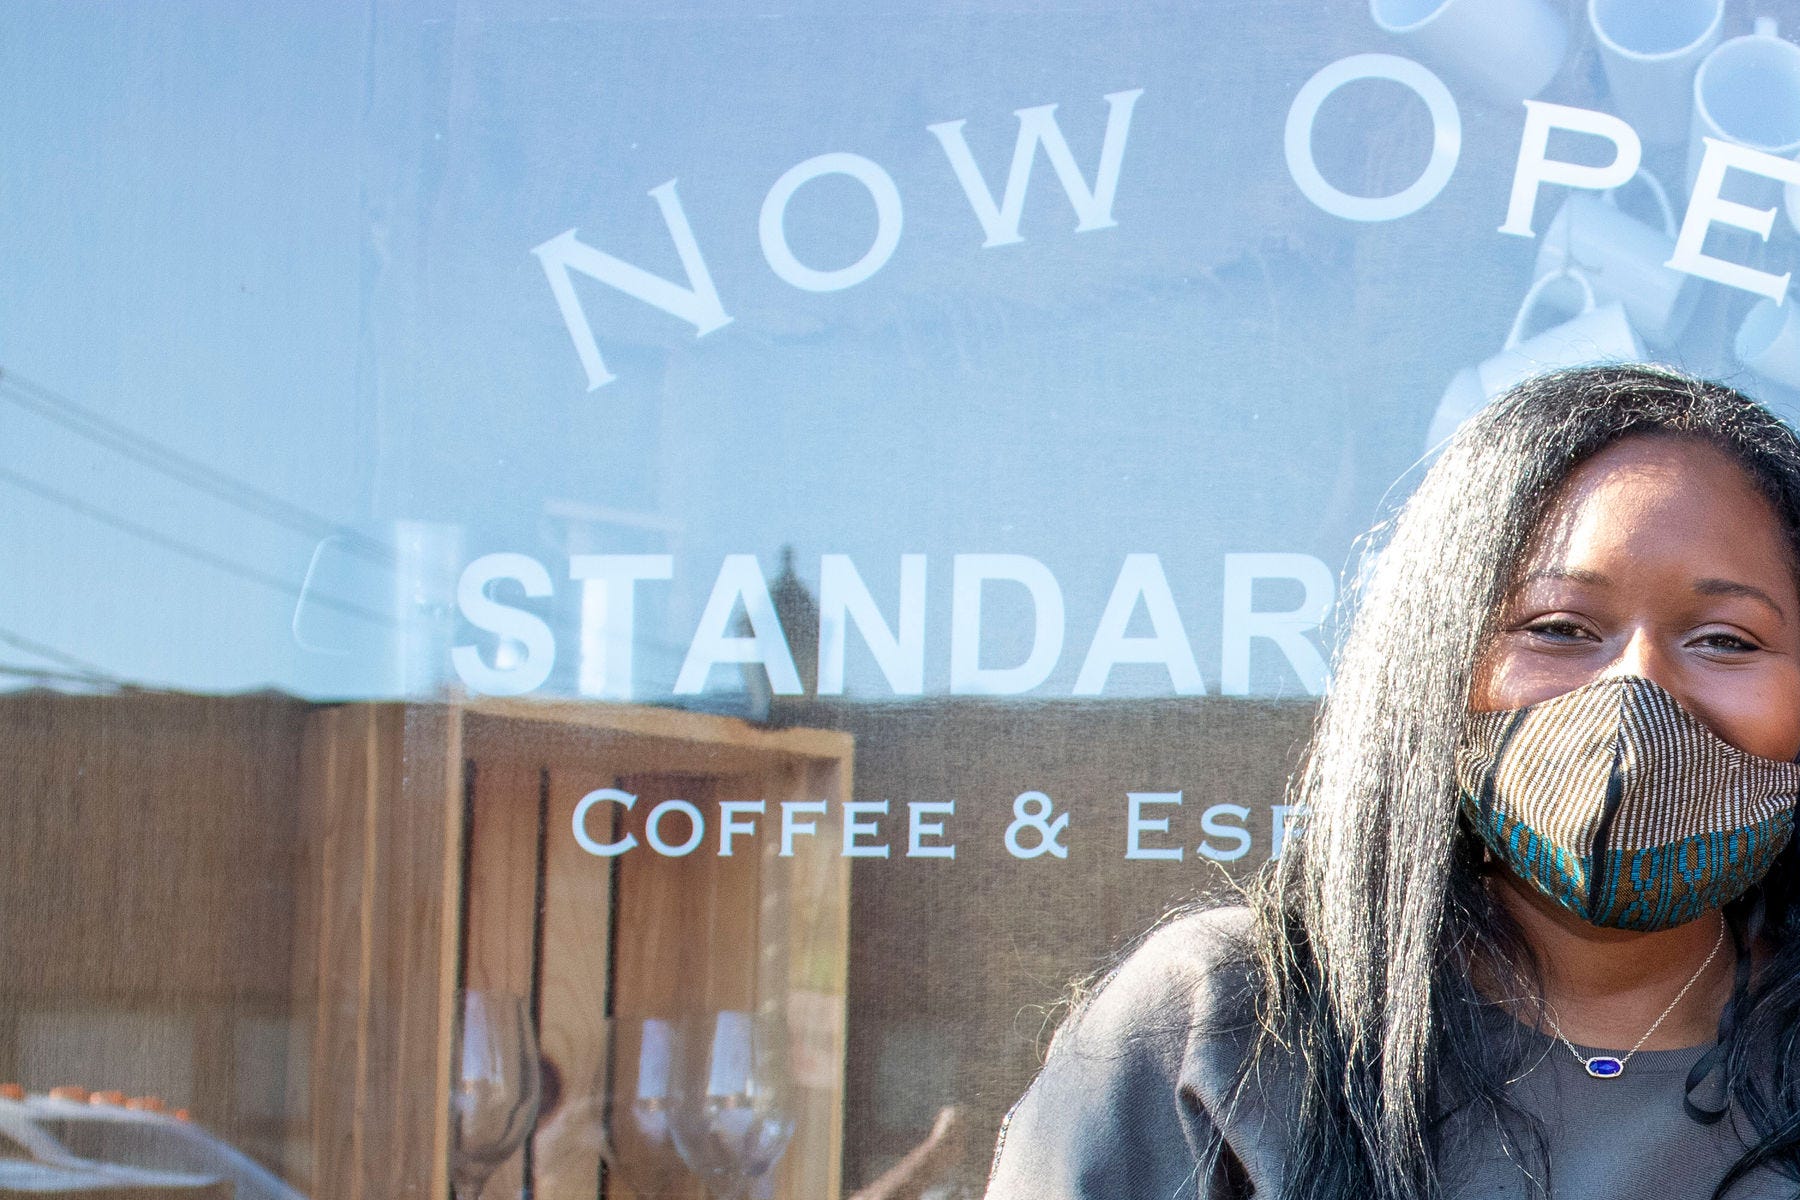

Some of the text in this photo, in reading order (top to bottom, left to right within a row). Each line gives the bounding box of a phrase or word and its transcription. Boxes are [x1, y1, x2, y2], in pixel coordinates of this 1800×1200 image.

[530, 88, 1145, 392] NOW
[452, 552, 1384, 697] STANDAR
[571, 788, 956, 860] COFFEE
[1003, 790, 1069, 860] &
